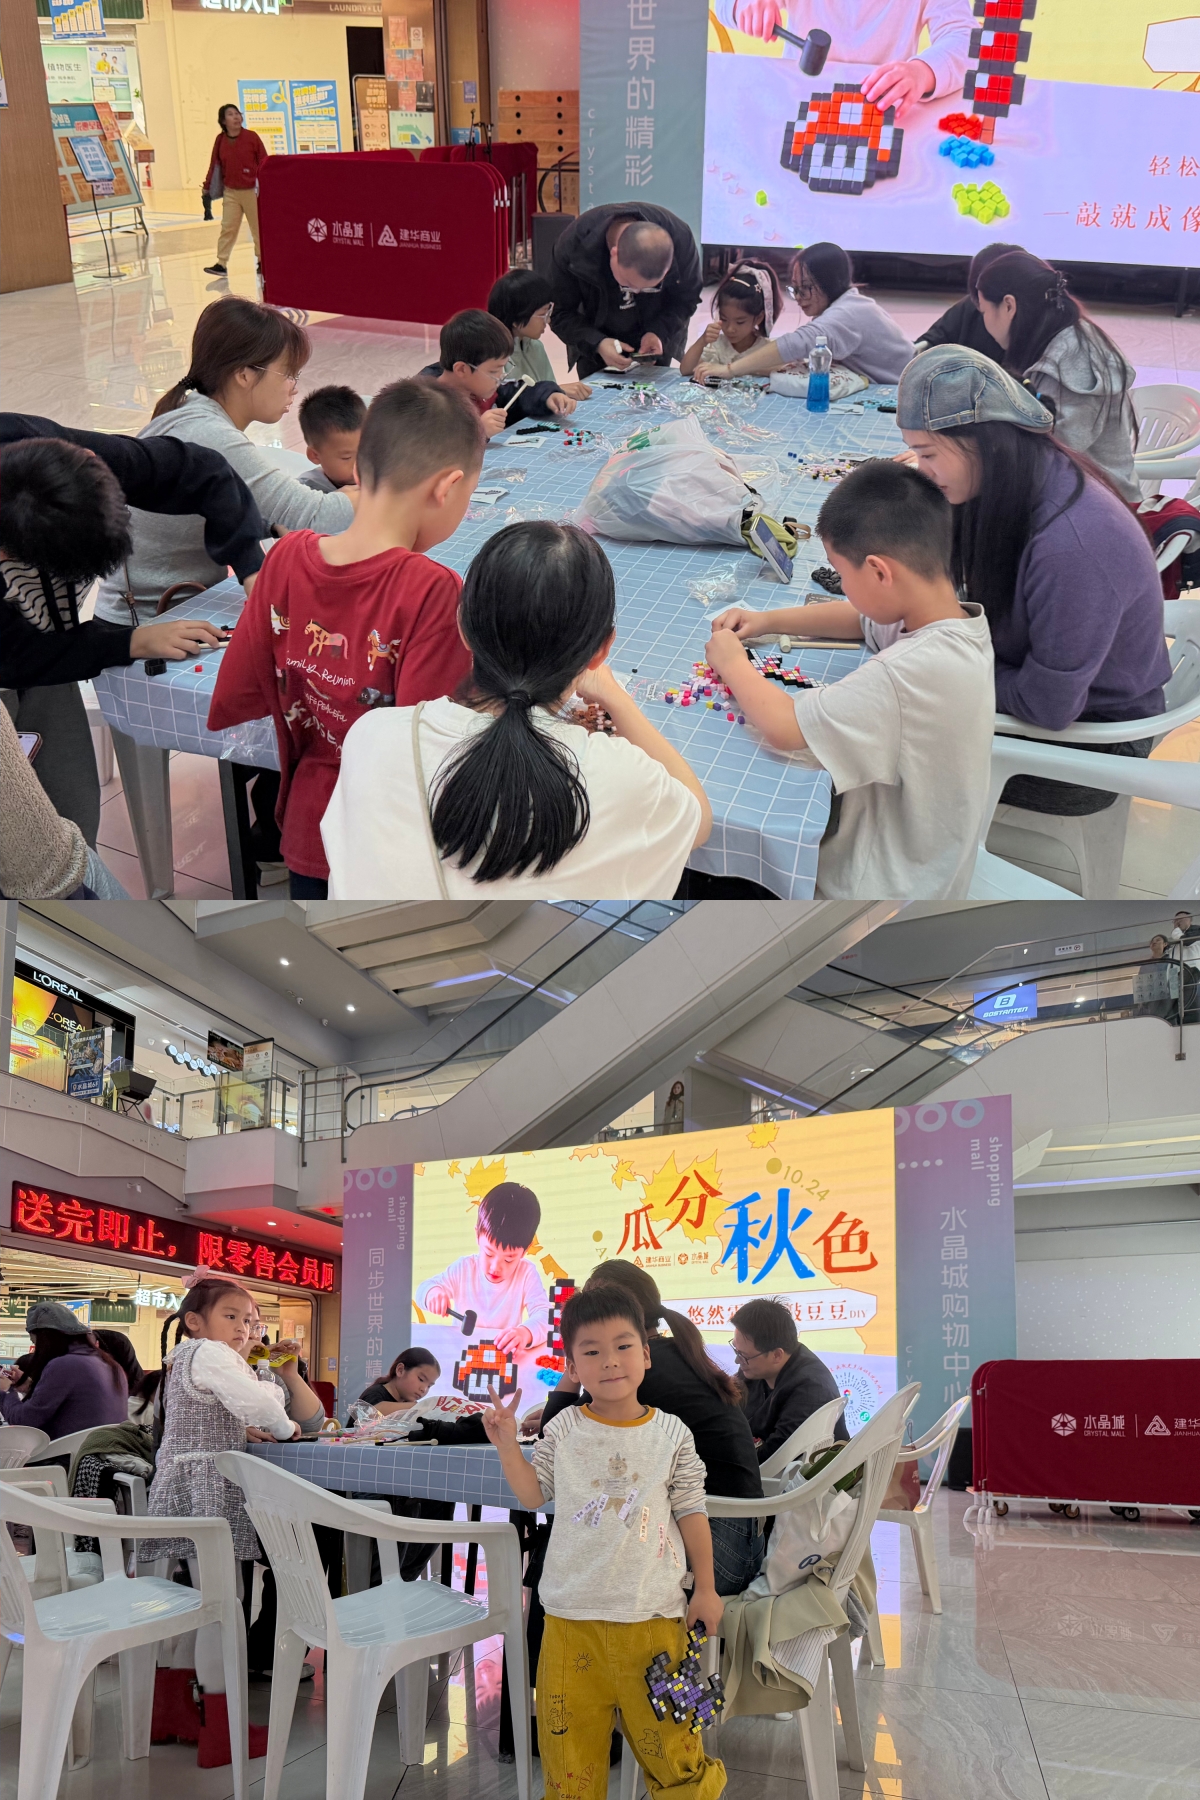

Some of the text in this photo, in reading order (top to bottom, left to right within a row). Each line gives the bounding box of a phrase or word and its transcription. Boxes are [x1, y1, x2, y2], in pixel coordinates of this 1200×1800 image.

[1148, 155, 1200, 178] 轻松
[332, 220, 364, 239] 水晶城
[399, 228, 441, 243] 建华商业
[983, 1006, 1029, 1018] BOSTANTEN
[969, 1138, 981, 1171] mall
[782, 1164, 831, 1204] 10.24
[987, 1136, 1001, 1208] shopping
[388, 1197, 397, 1222] mall
[397, 1196, 408, 1250] shopping
[618, 1169, 879, 1285] 瓜分秋色
[135, 1288, 181, 1312] 超市入
[365, 1248, 386, 1388] 同步世界的精
[1084, 1414, 1126, 1430] 水晶城
[1084, 1430, 1126, 1438] CRYSTAL MALL
